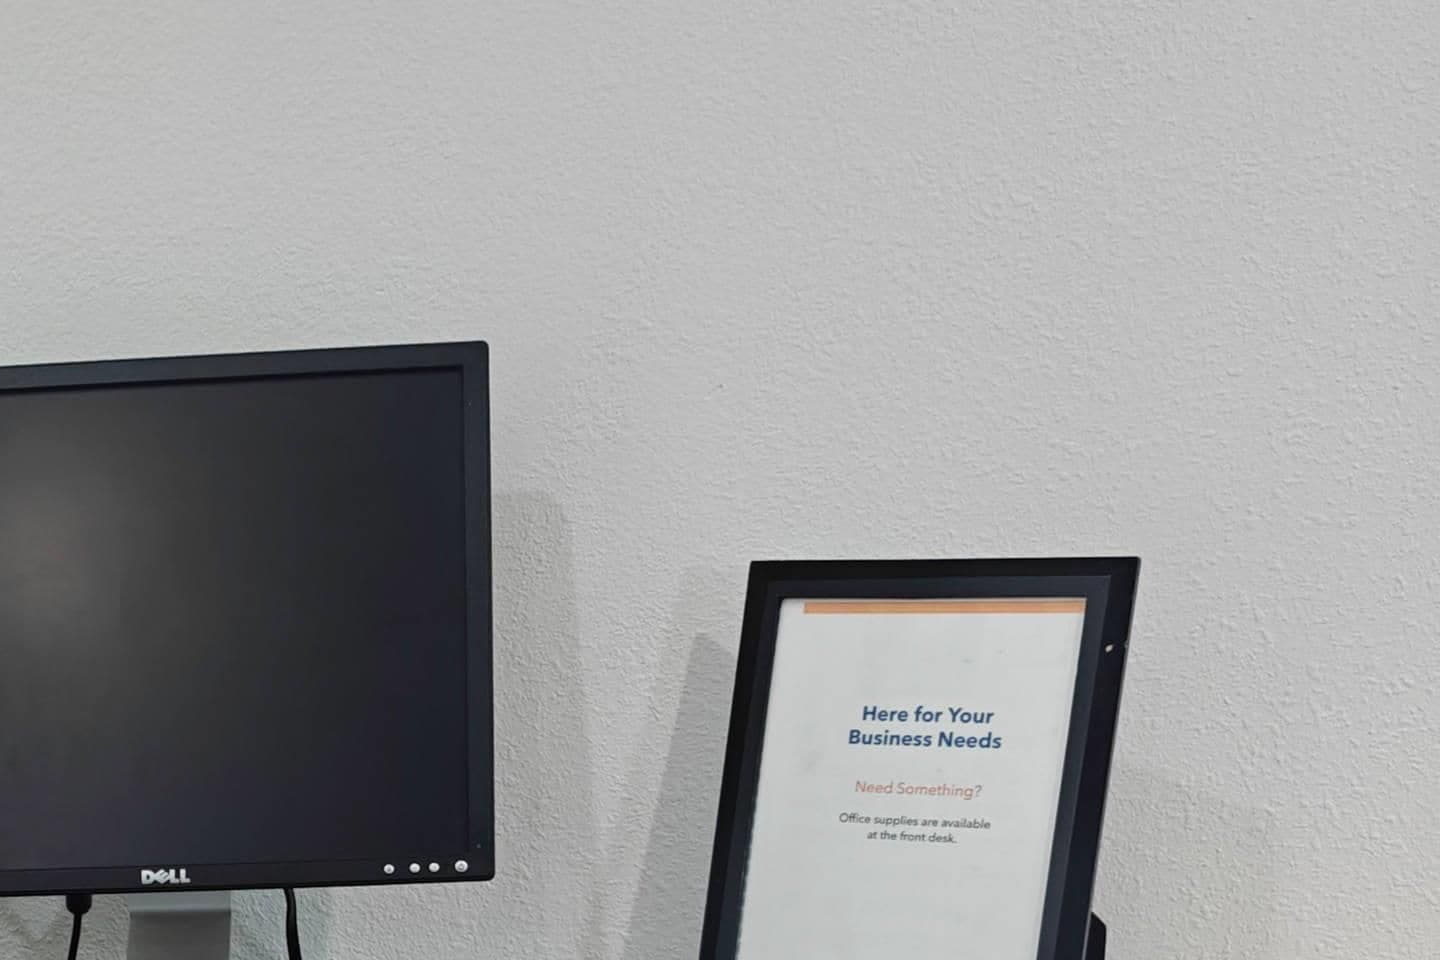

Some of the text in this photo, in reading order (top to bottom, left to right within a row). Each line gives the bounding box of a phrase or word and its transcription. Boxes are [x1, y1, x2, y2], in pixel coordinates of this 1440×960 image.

[862, 705, 994, 724] Here for Your
[848, 729, 1002, 749] Business Needs
[855, 780, 982, 800] Need Something?
[839, 812, 991, 830] Office supplies are available
[867, 830, 958, 844] at the front desk.
[141, 868, 191, 884] DELL
